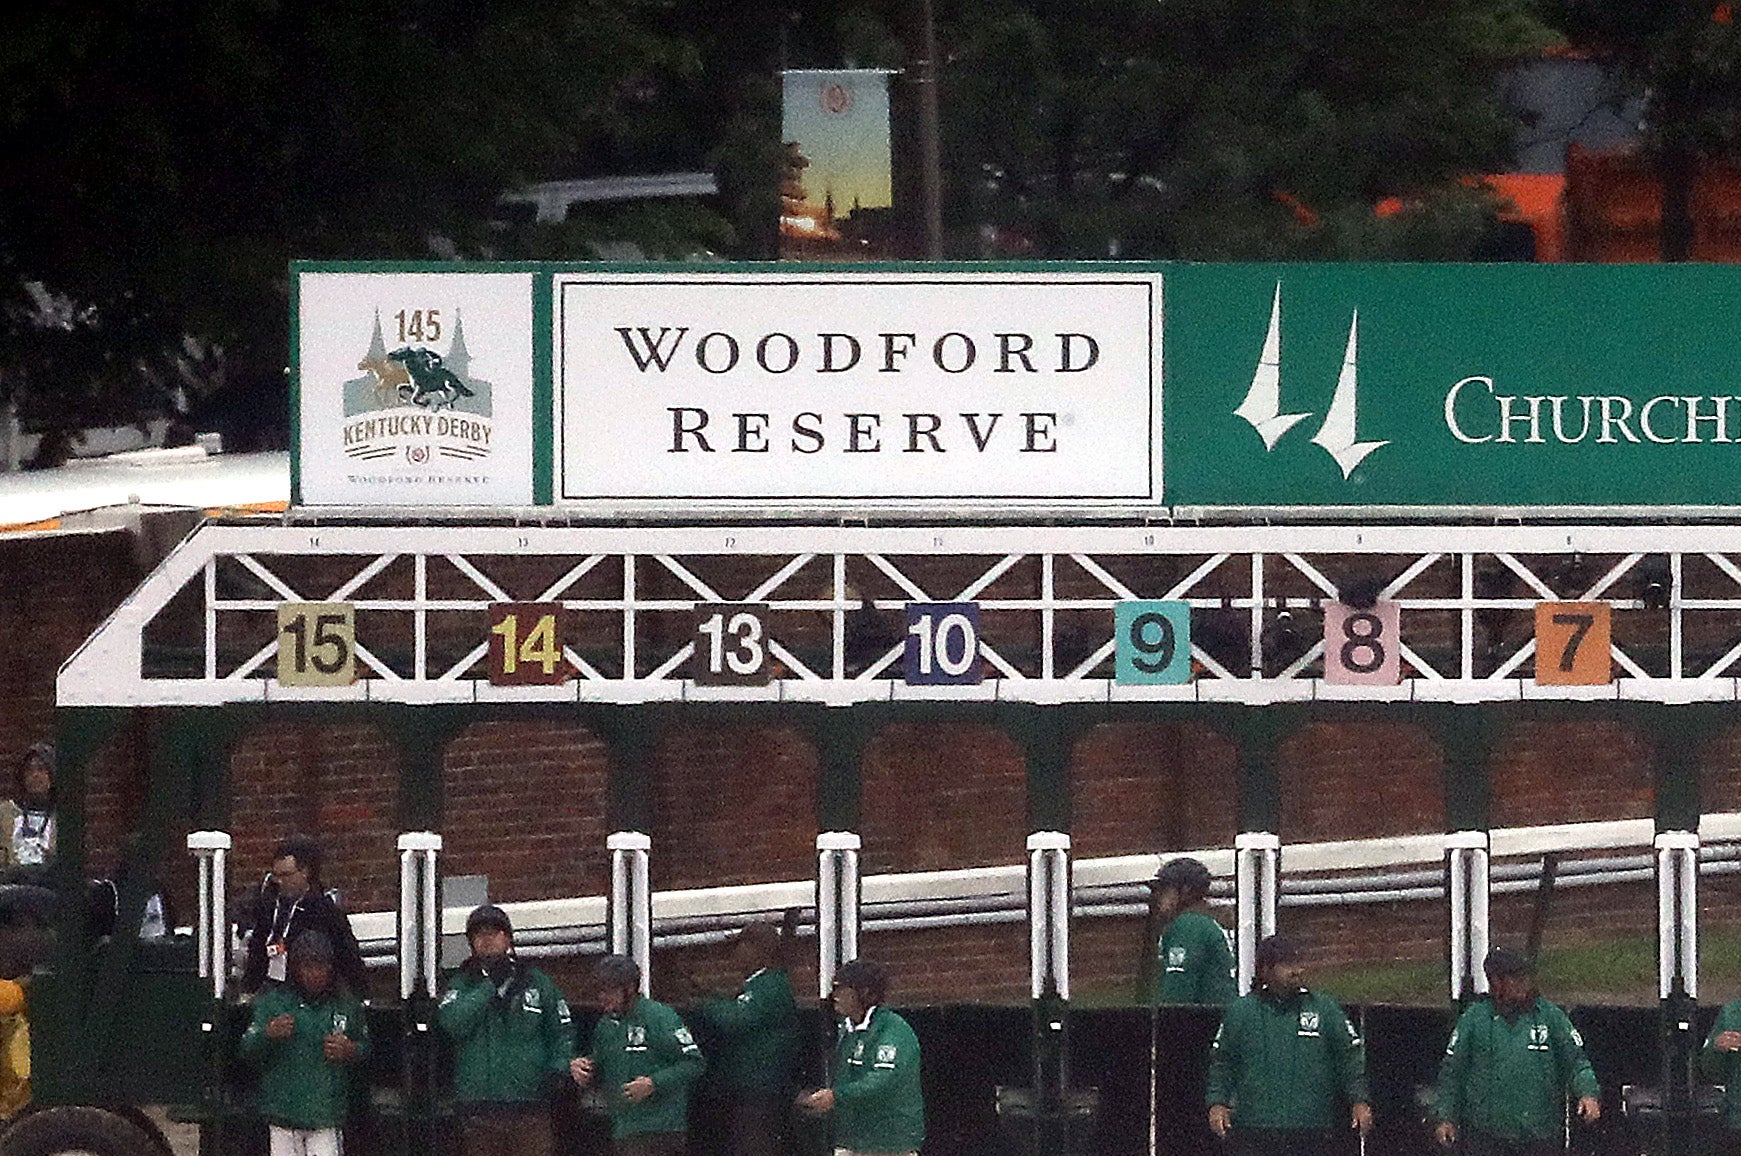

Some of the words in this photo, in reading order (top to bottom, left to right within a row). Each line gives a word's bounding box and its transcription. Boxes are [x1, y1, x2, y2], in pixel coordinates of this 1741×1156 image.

[394, 309, 442, 342] 145
[615, 327, 1100, 374] WOODFORD
[343, 415, 433, 446] KENTUCKY
[436, 416, 492, 445] DERBY
[667, 407, 1058, 454] RESERVE
[283, 614, 349, 674] 15
[492, 614, 561, 674] 14
[699, 613, 764, 674] 13
[908, 613, 976, 676] 10
[1130, 612, 1176, 674] 9
[1340, 612, 1385, 674] 8
[1552, 613, 1595, 672] 7
